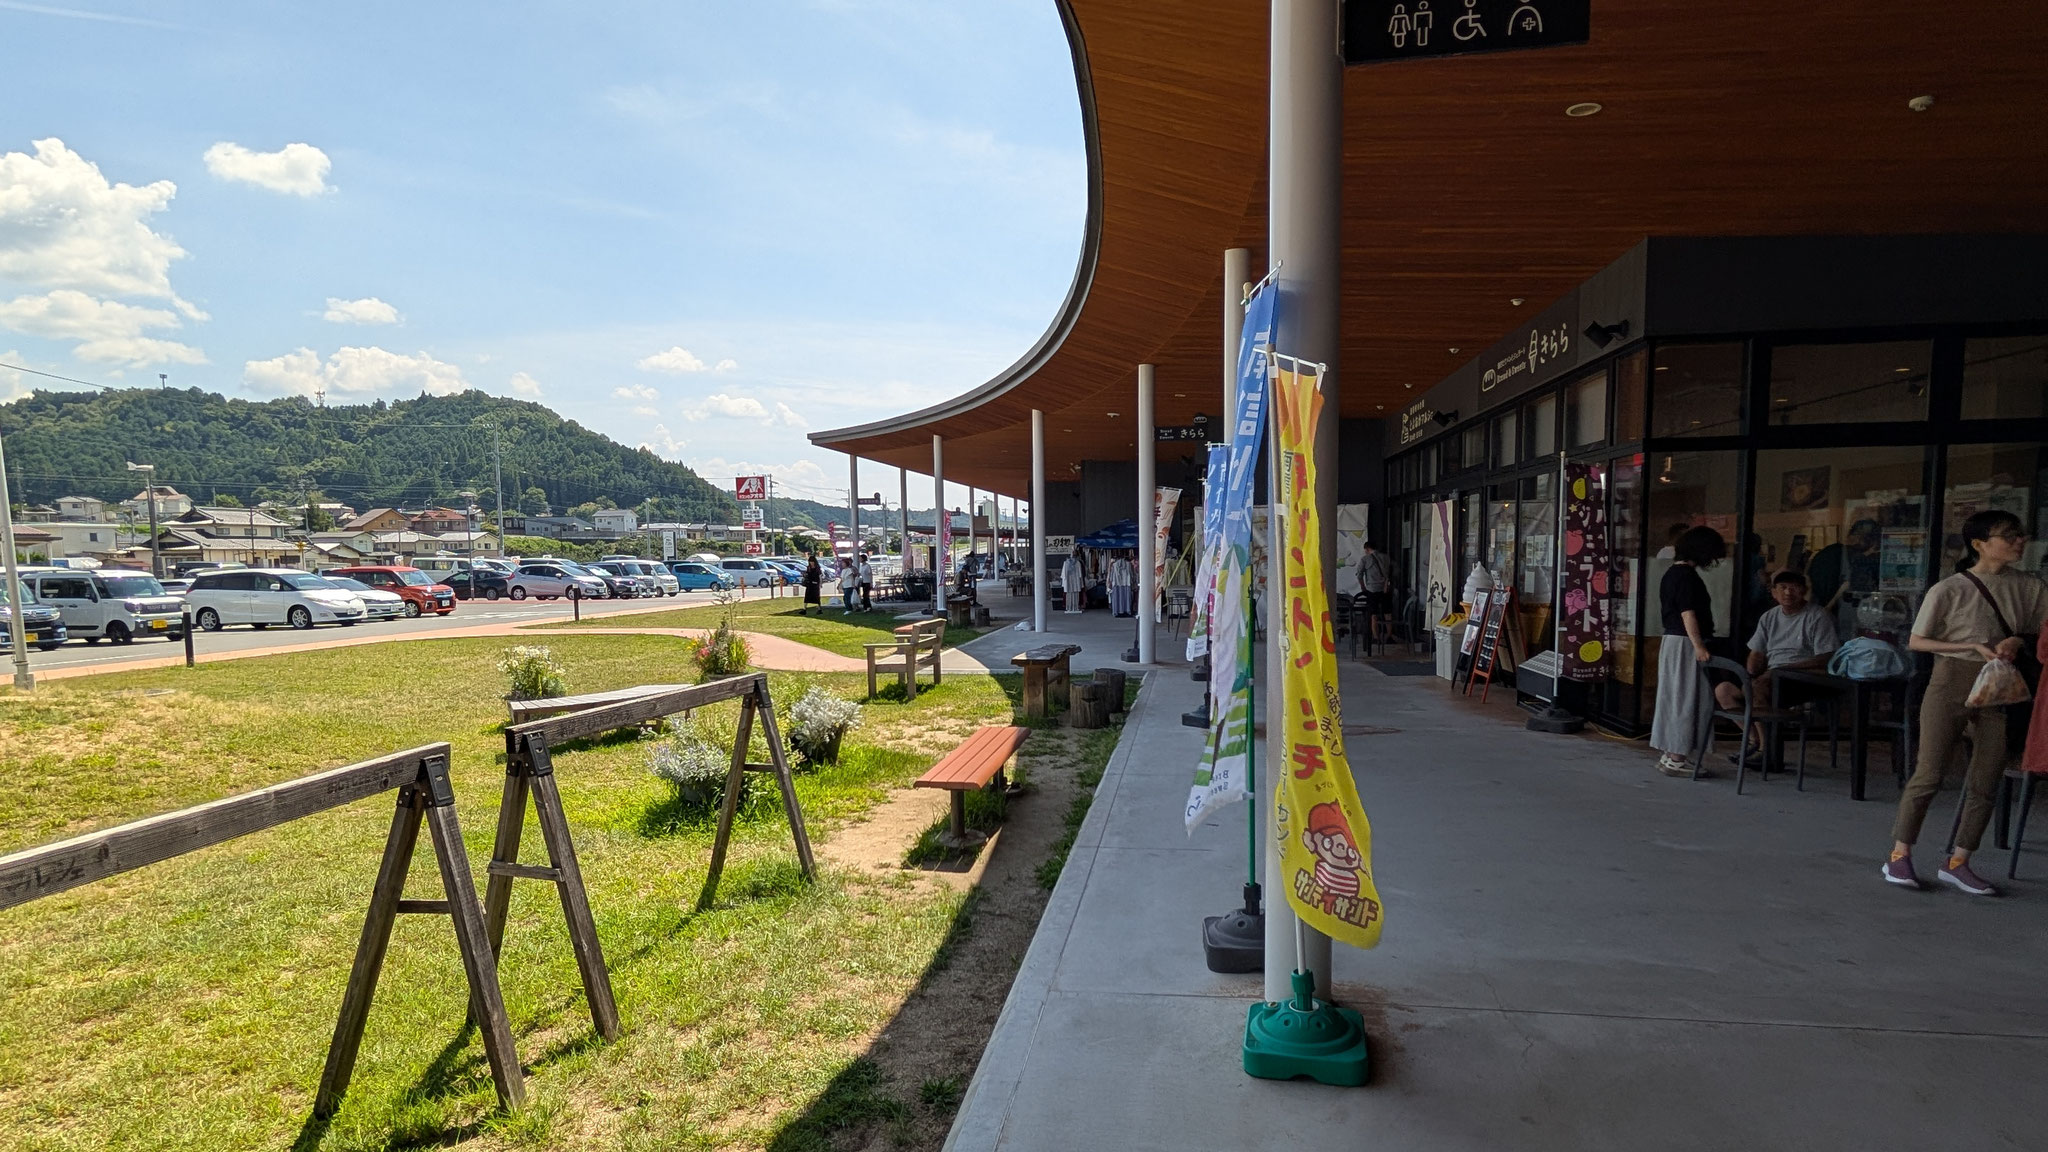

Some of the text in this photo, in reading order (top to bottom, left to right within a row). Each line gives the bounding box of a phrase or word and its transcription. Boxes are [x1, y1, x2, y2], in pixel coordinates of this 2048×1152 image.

[1540, 322, 1569, 364] きらら
[1180, 428, 1205, 438] きらら
[746, 545, 753, 553] P
